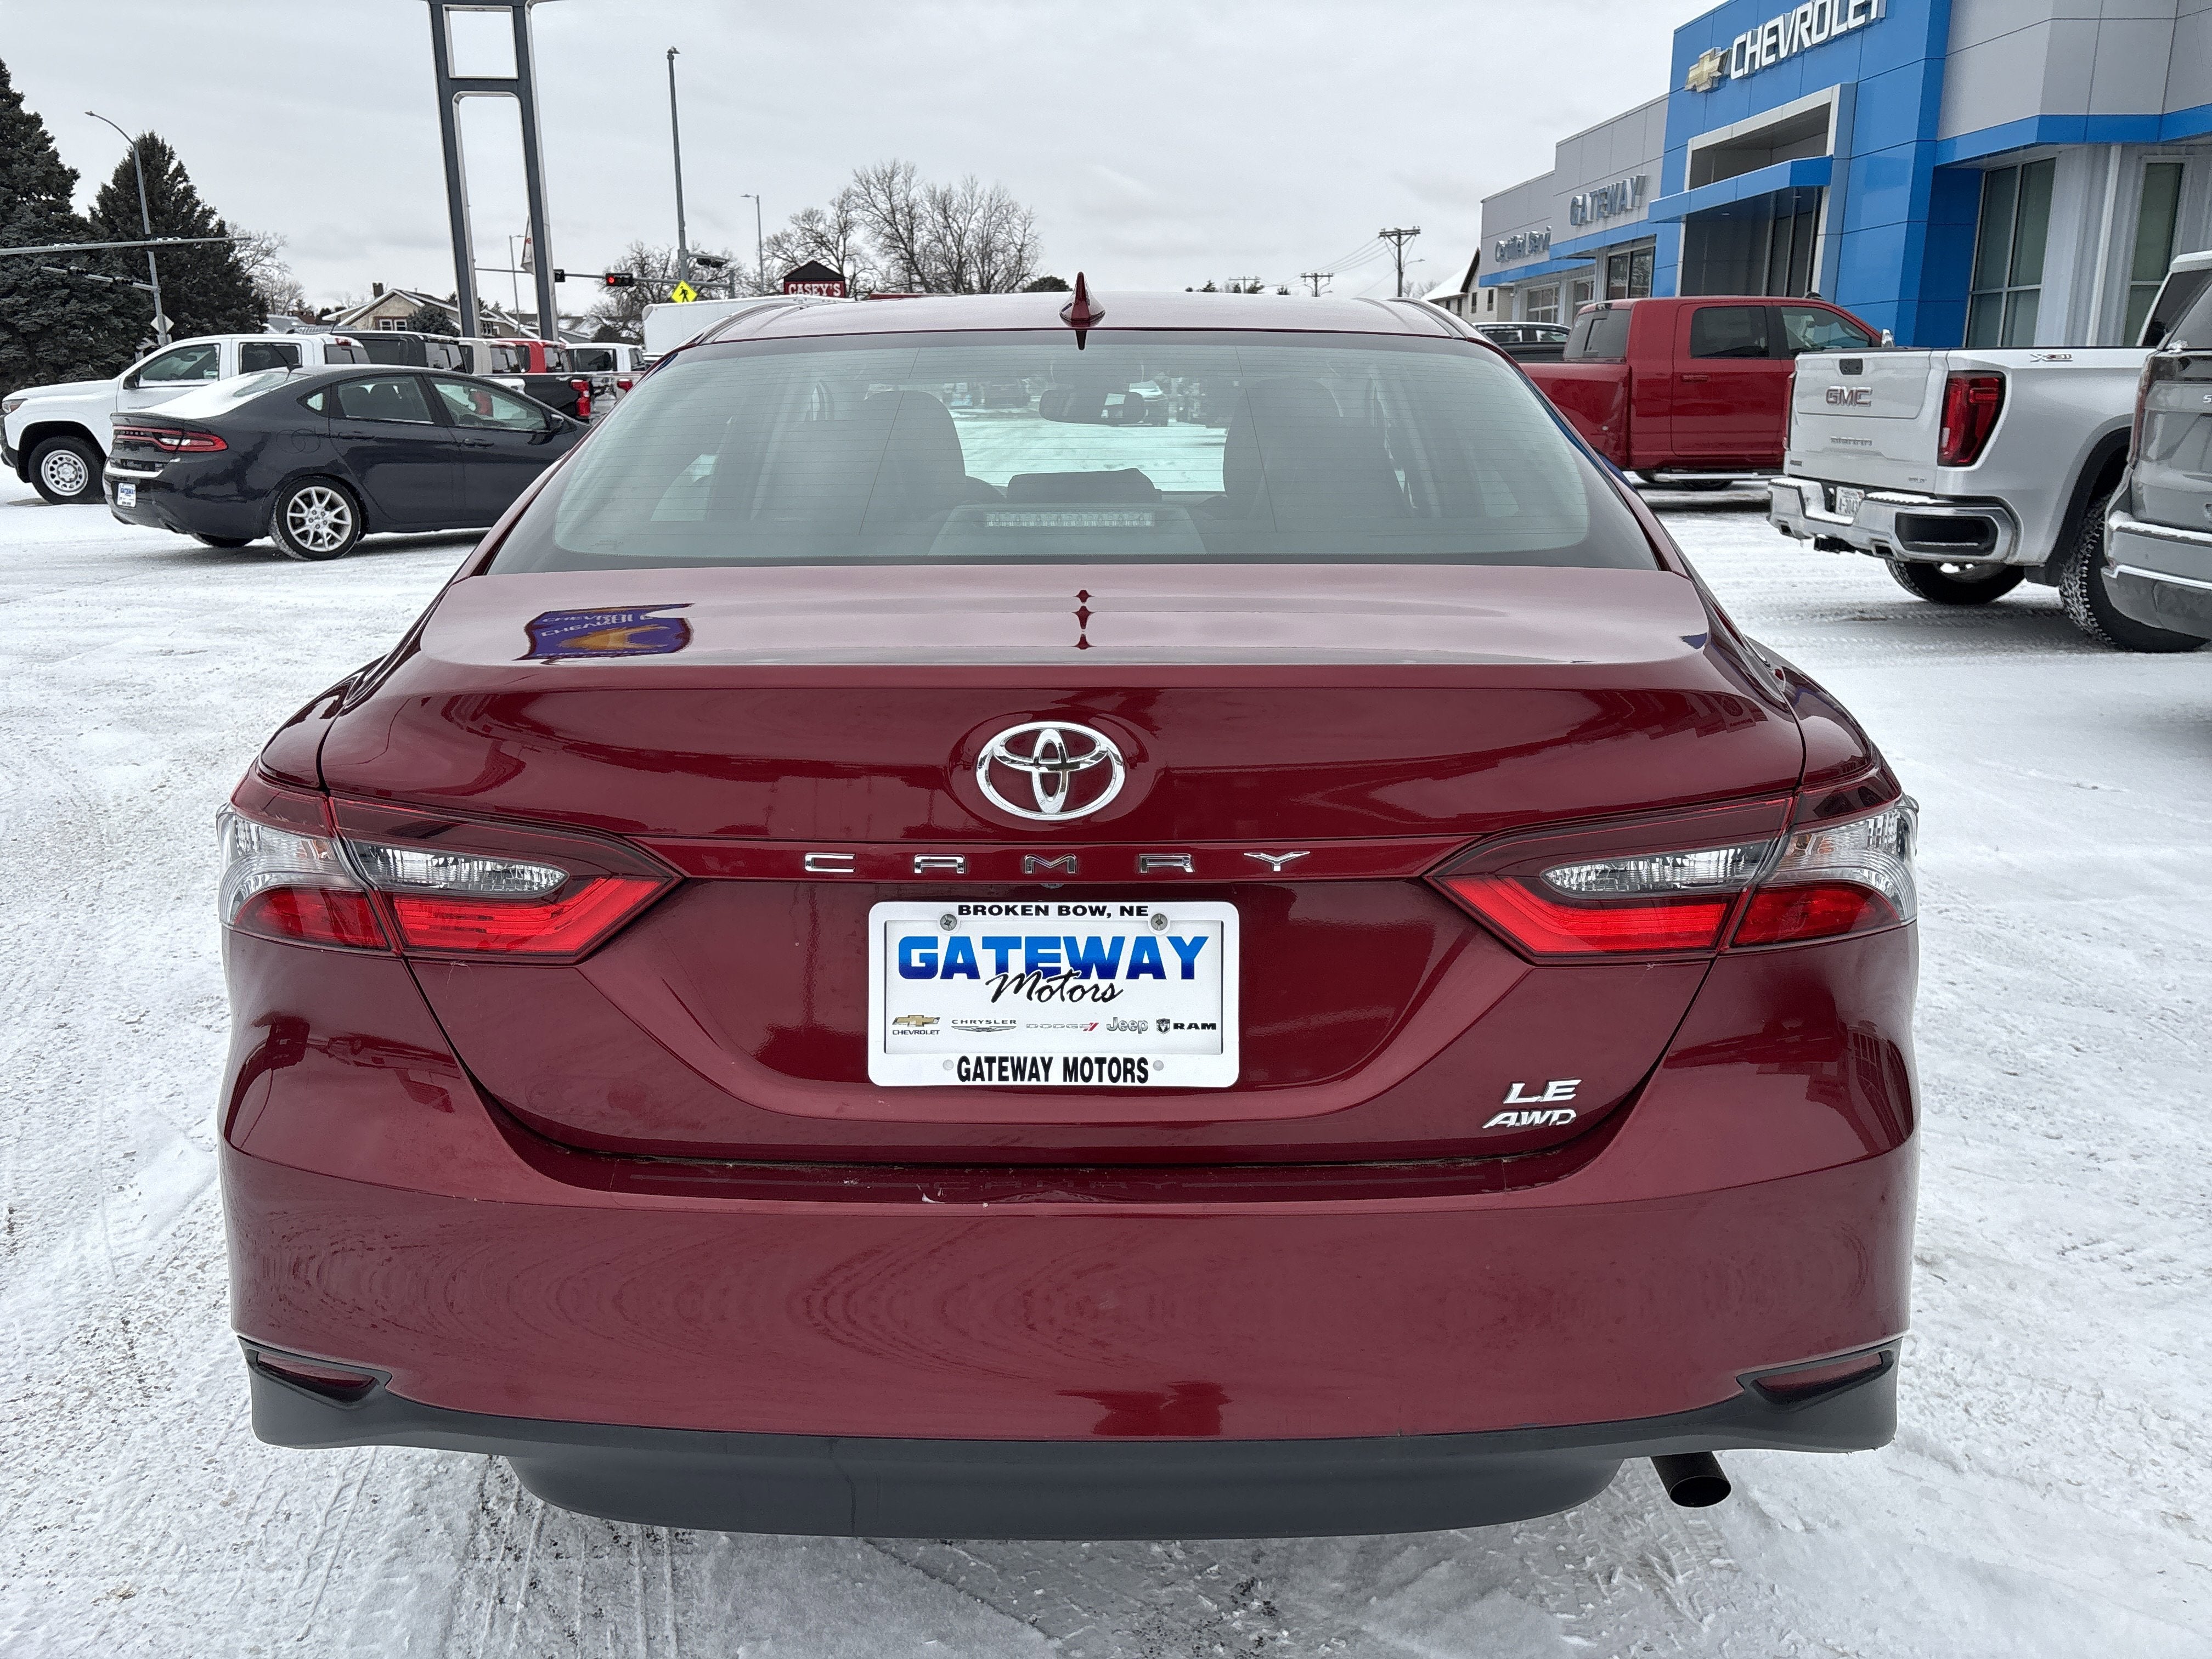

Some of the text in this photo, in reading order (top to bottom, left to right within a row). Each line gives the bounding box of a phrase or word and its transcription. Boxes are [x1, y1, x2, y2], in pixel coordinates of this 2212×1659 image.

[1570, 174, 1646, 225] GATEWAY
[788, 283, 841, 296] CASEY'S
[1826, 386, 1872, 407] GMC
[804, 850, 1310, 875] CAMRY
[958, 905, 1149, 918] BROKEN BOW, NE
[898, 936, 1209, 980] GATEWAY
[985, 968, 1124, 1003] Motors
[1106, 1017, 1149, 1034] Jeep
[957, 1055, 1149, 1084] GATEWAY MOTORS
[1503, 1079, 1582, 1104] LE
[1481, 1109, 1577, 1129] AWD
